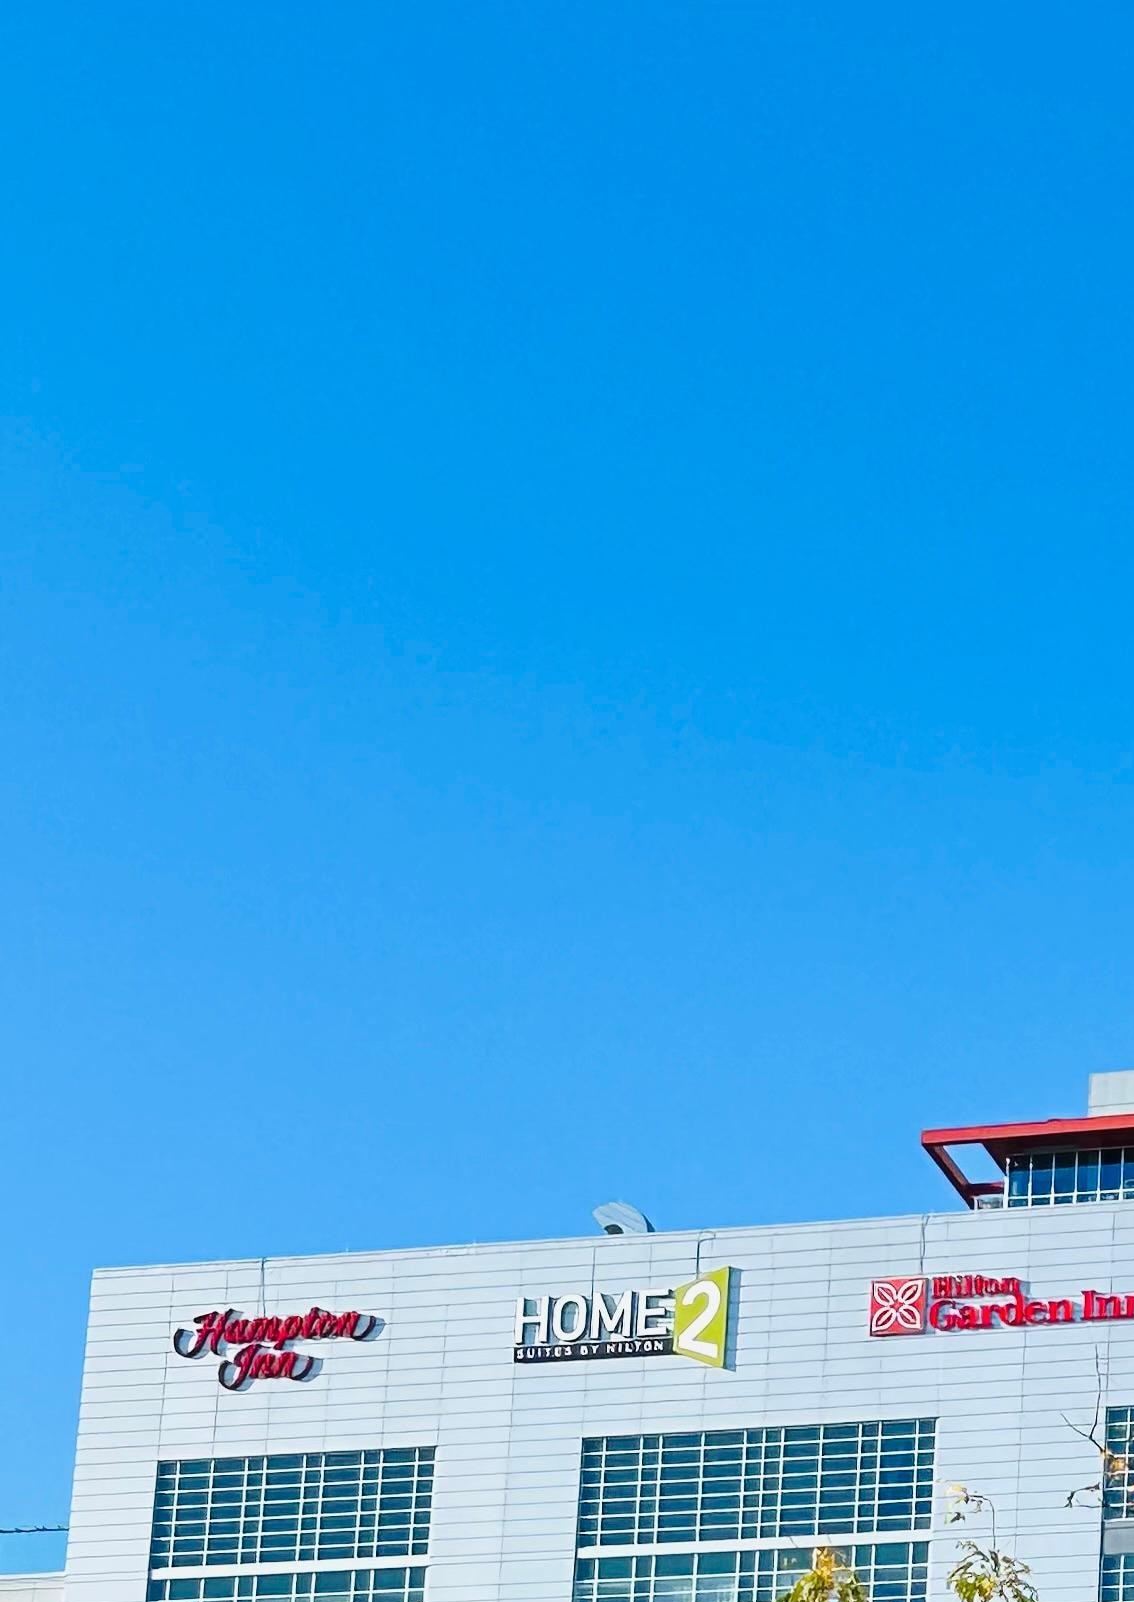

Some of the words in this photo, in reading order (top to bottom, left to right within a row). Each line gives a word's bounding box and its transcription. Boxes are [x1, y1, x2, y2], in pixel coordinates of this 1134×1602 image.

[932, 1274, 1020, 1299] Hilton
[929, 1292, 1075, 1331] Garden
[173, 1307, 380, 1359] Hampton
[516, 1346, 573, 1360] SUITES
[580, 1344, 600, 1356] BY
[606, 1340, 665, 1354] HILTON
[218, 1344, 317, 1391] Inn
